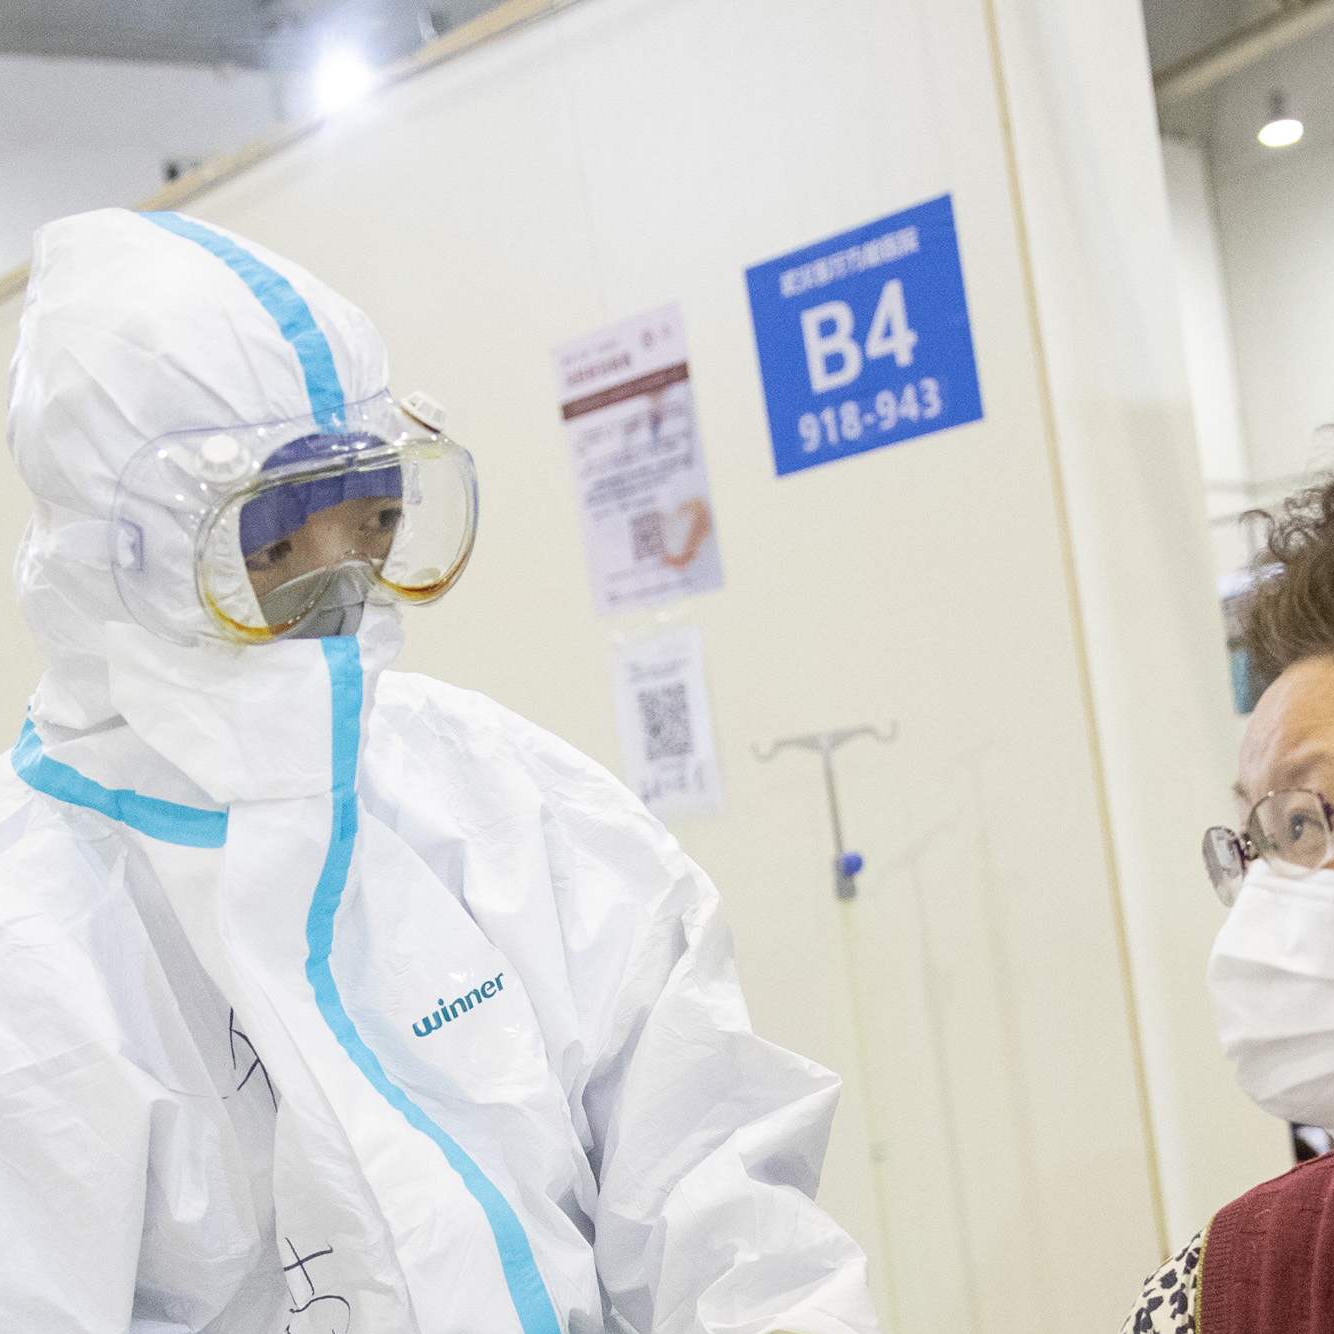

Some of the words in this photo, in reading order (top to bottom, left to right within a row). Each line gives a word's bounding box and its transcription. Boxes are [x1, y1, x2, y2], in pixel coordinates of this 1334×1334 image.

[800, 277, 918, 396] B4
[797, 375, 944, 453] 918-943
[412, 972, 504, 1038] winner
